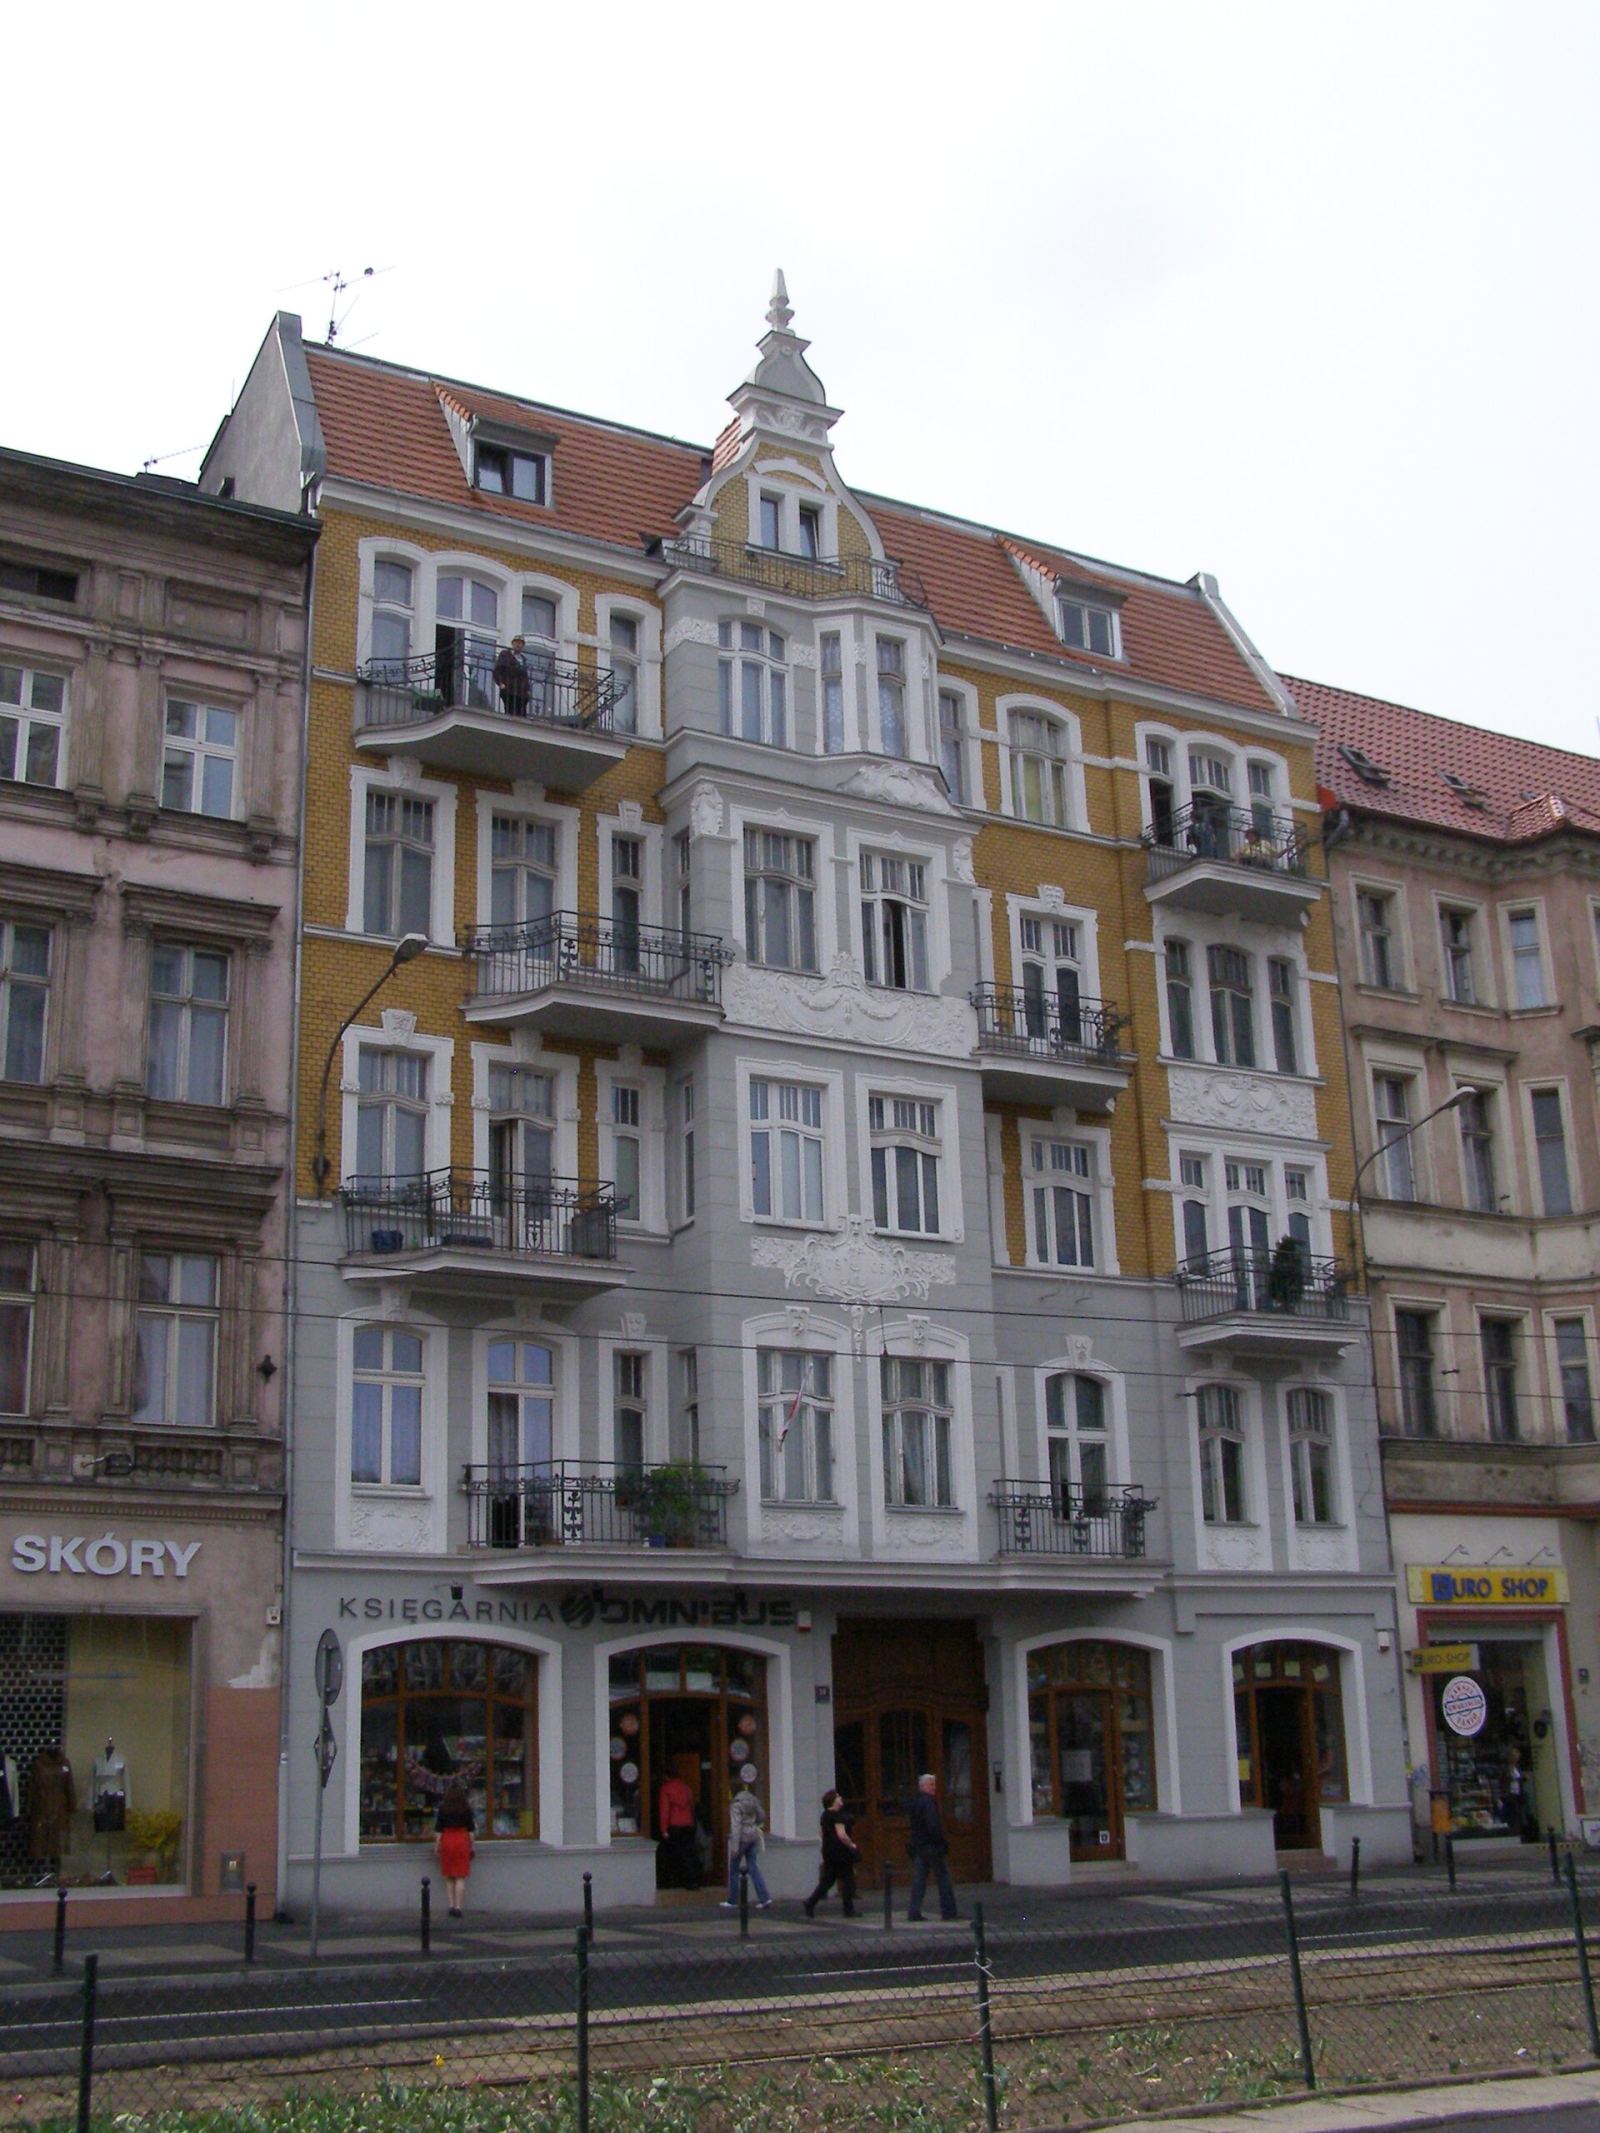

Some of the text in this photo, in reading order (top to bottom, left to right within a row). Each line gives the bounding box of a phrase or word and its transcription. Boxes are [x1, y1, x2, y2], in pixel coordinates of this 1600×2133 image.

[12, 1532, 202, 1577] SKÓRY
[1501, 1577, 1548, 1598] SHOP
[339, 1598, 794, 1625] KSIĘGARNIA OMNIBUS
